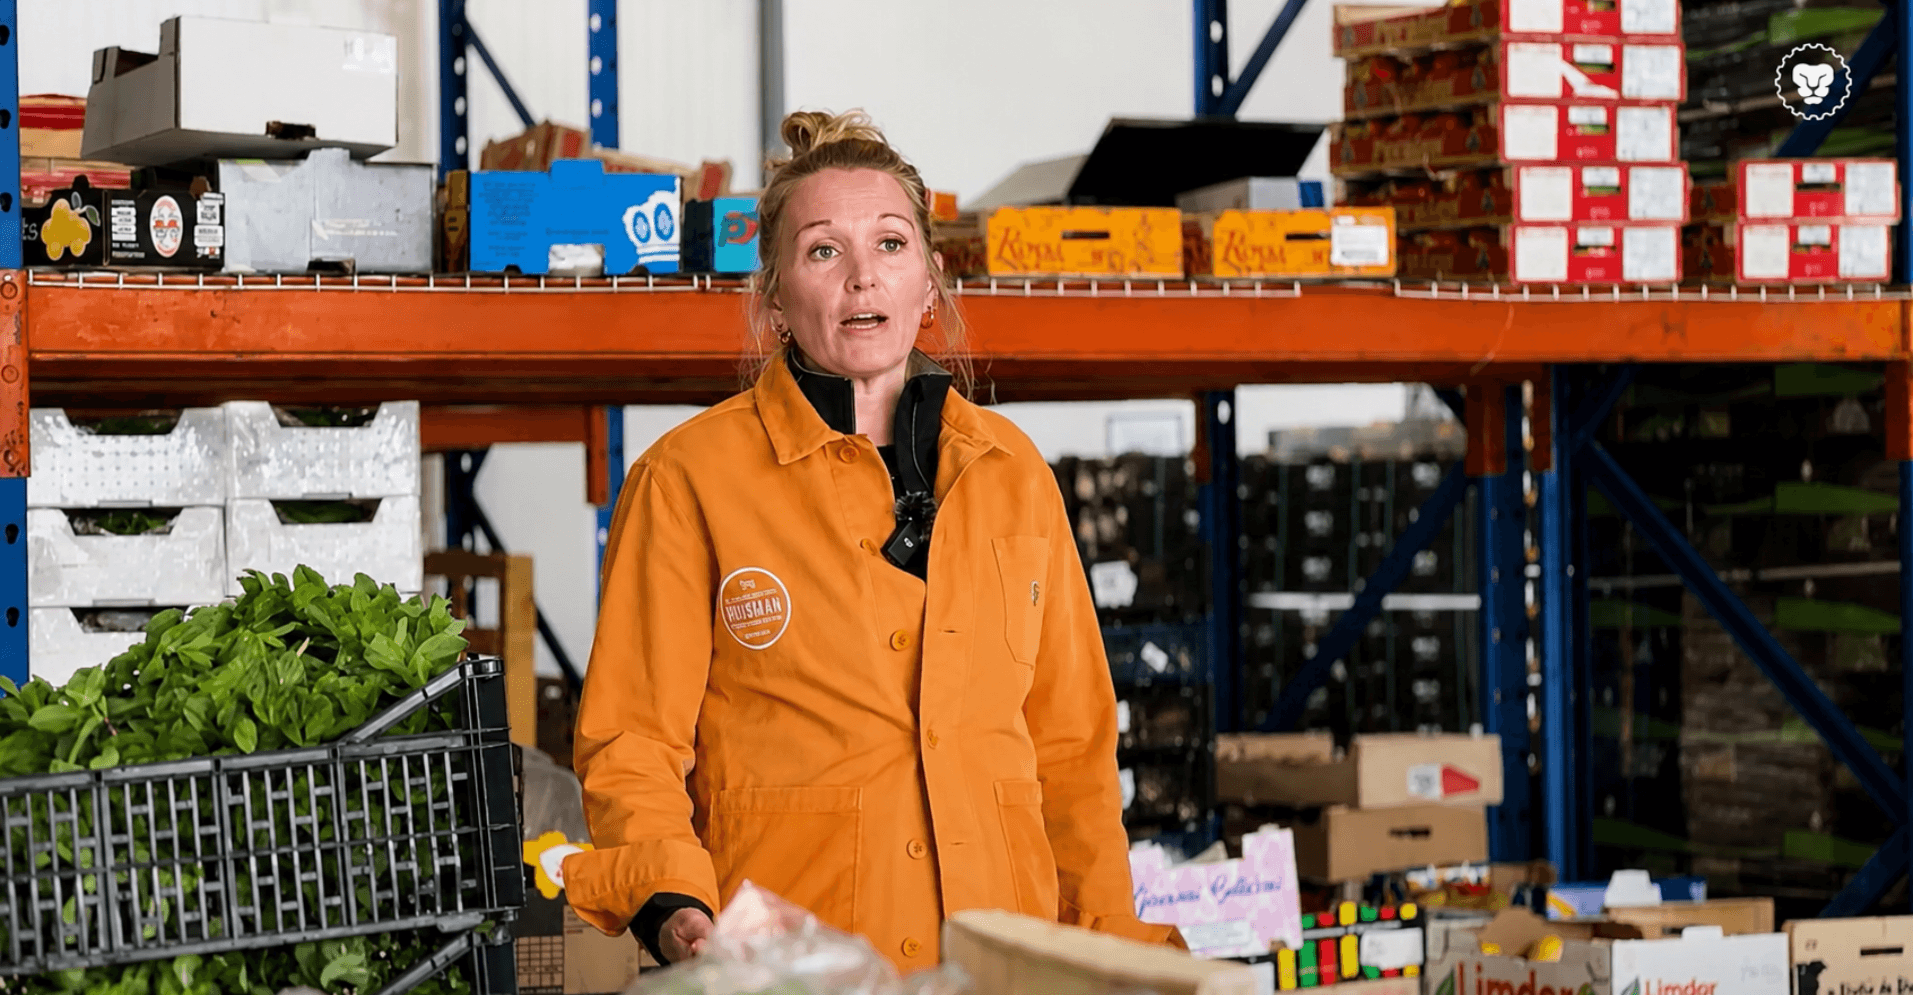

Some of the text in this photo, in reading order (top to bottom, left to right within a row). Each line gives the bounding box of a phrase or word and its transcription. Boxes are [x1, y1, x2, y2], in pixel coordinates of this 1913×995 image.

[725, 597, 782, 622] HUISMAN
[1457, 961, 1574, 995] Limd
[1645, 976, 1717, 995] Limdor
